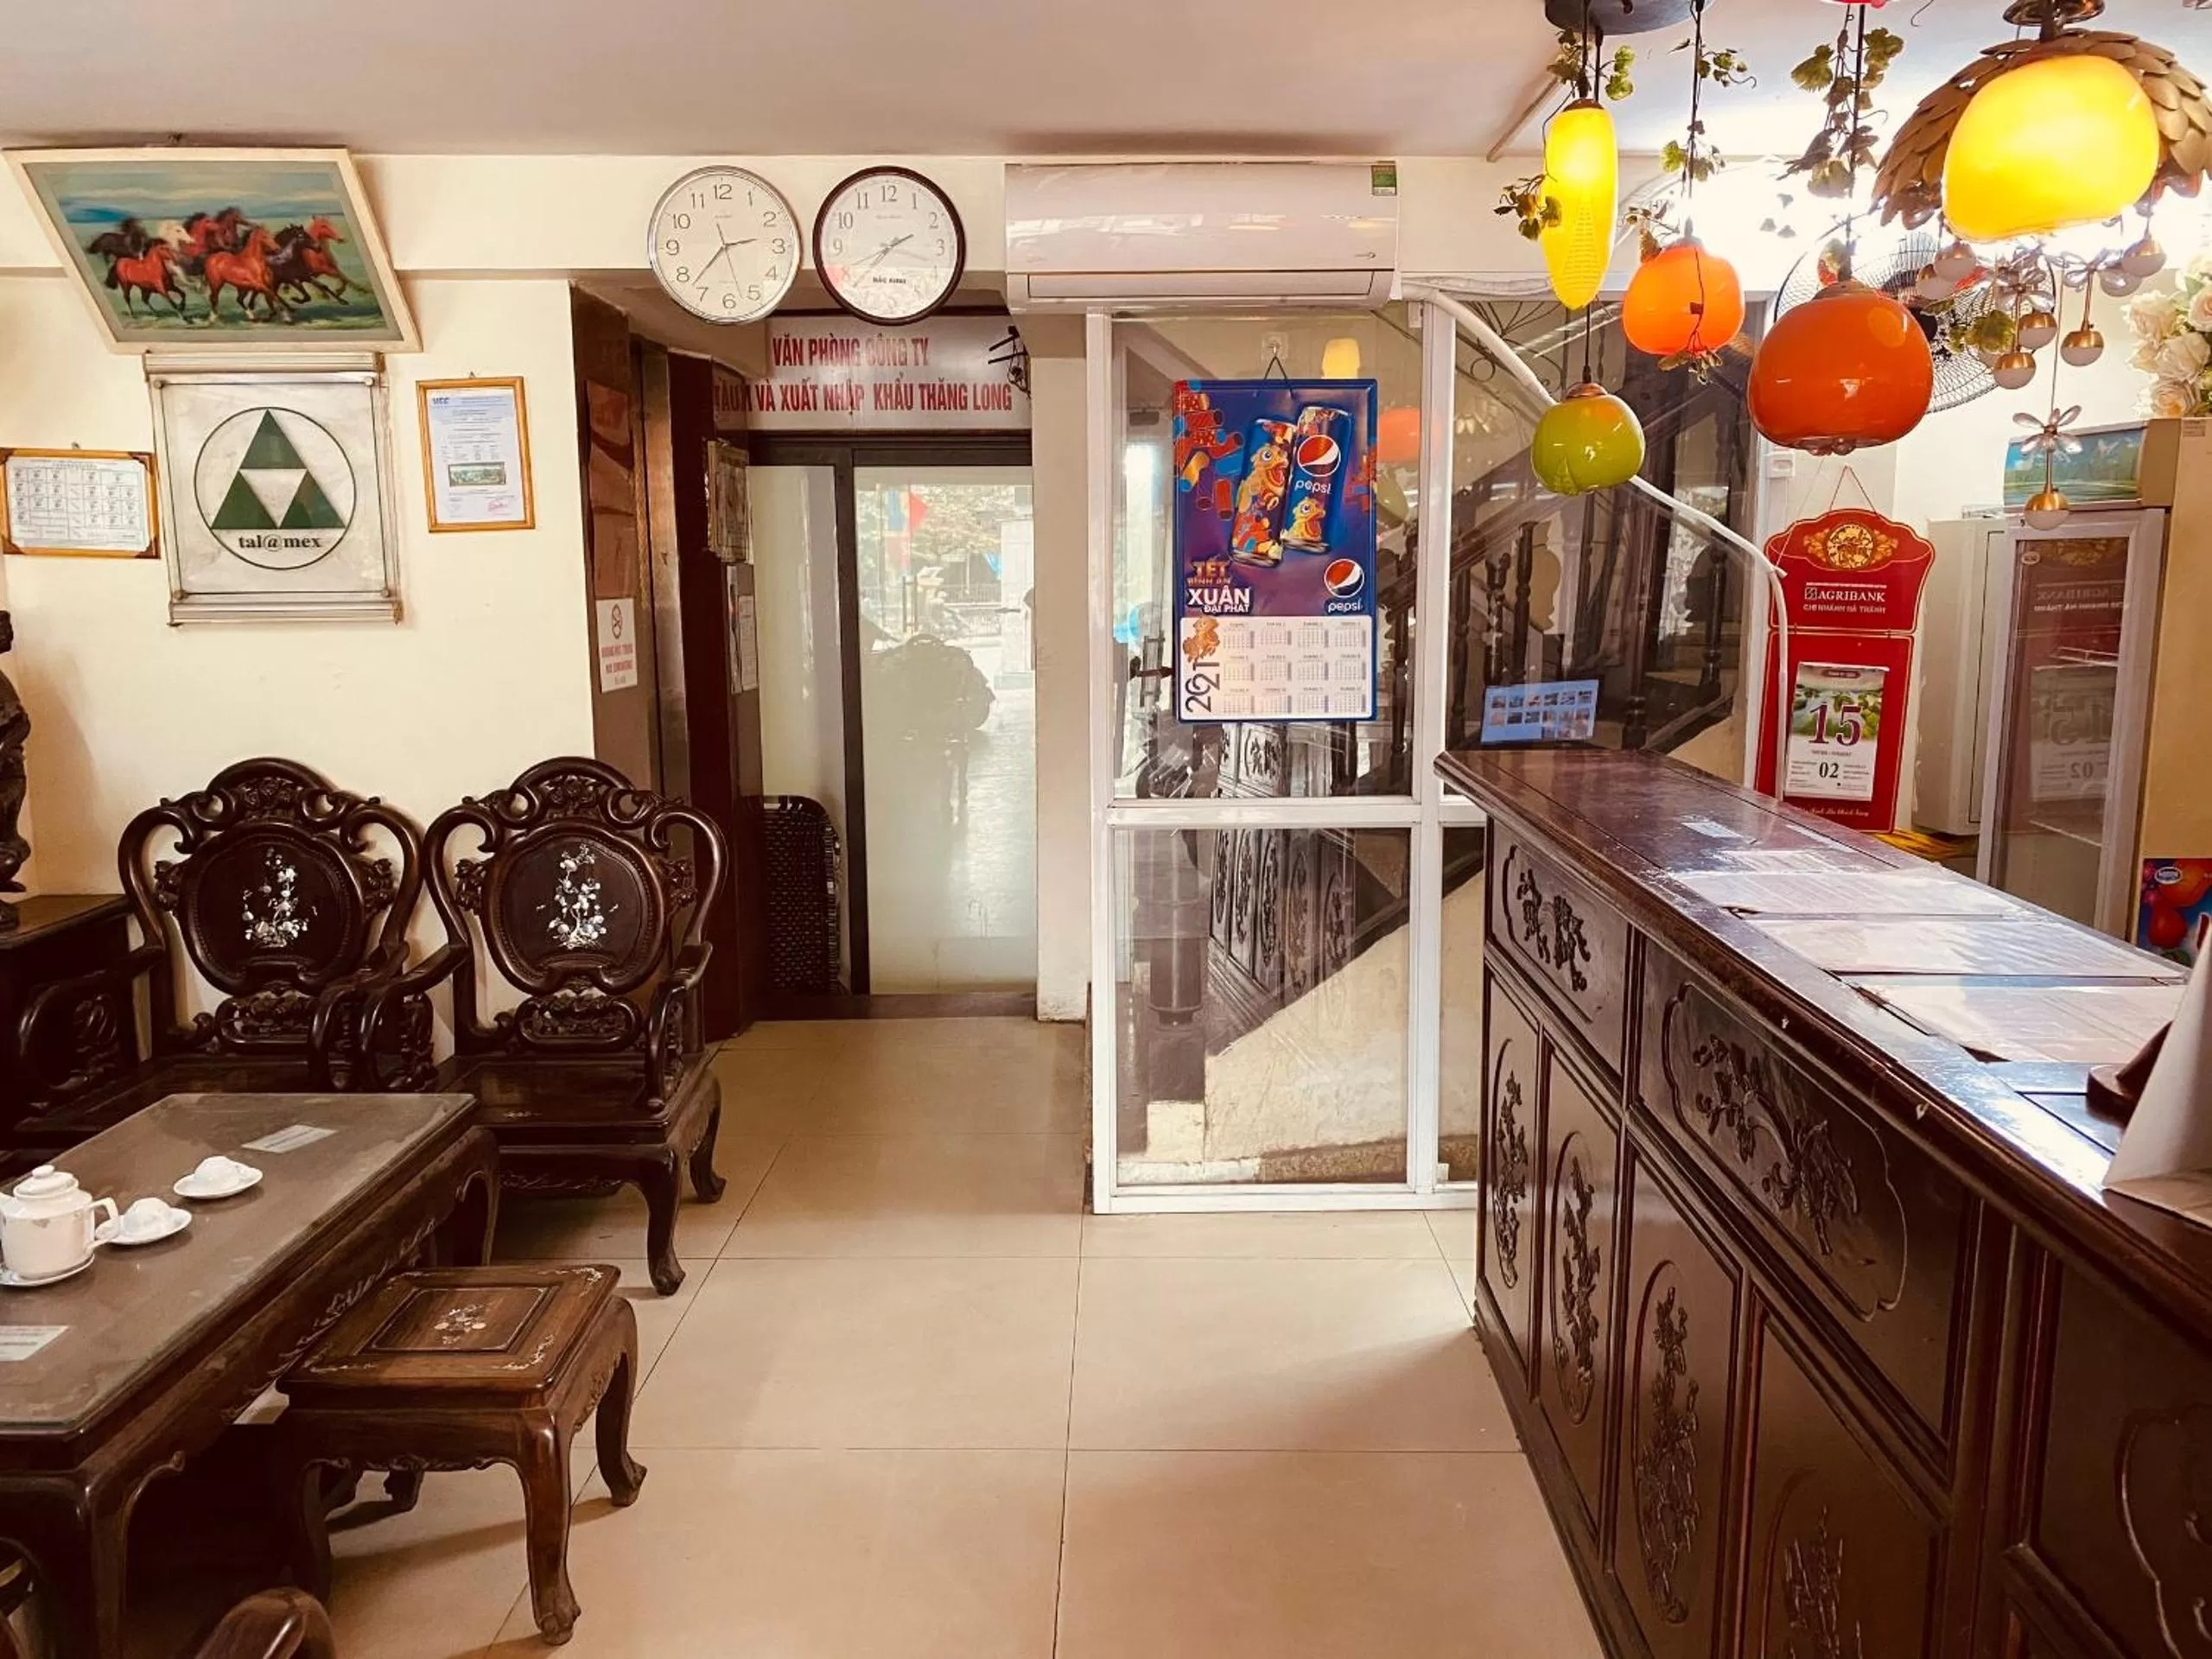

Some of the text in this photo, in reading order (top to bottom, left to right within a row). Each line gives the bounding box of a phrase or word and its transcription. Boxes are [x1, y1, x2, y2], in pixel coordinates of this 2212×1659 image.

[691, 193, 705, 208] 11
[713, 184, 733, 200] 12
[747, 190, 753, 207] 1
[857, 192, 869, 209] 11
[880, 185, 898, 202] 12
[912, 192, 918, 210] 1
[673, 213, 691, 229] 10
[763, 211, 777, 227] 2
[837, 211, 854, 229] 10
[928, 211, 939, 229] 2
[665, 239, 680, 256] 9
[772, 238, 785, 255] 3
[832, 238, 843, 257] 9
[935, 238, 945, 257] 3
[677, 266, 690, 283] 8
[765, 265, 777, 281] 4
[696, 286, 709, 302] 7
[722, 293, 736, 309] 6
[747, 284, 761, 301] 5
[772, 332, 930, 366] VĂN PHÒNG CÔNG TY
[754, 378, 776, 411] VÀ
[779, 377, 818, 411] XUẤT
[823, 378, 865, 416] NHẬP
[873, 372, 914, 410] KHẨU
[918, 377, 969, 410] THĂNG
[973, 383, 1013, 410] LONG
[238, 534, 322, 552] tal@mex
[1187, 585, 1251, 606] XUÂN
[1817, 589, 1886, 603] AGRIBANK
[1328, 598, 1362, 613] pepsi
[1185, 662, 1220, 713] 2021
[1808, 702, 1862, 747] 15
[1818, 762, 1840, 778] 02
